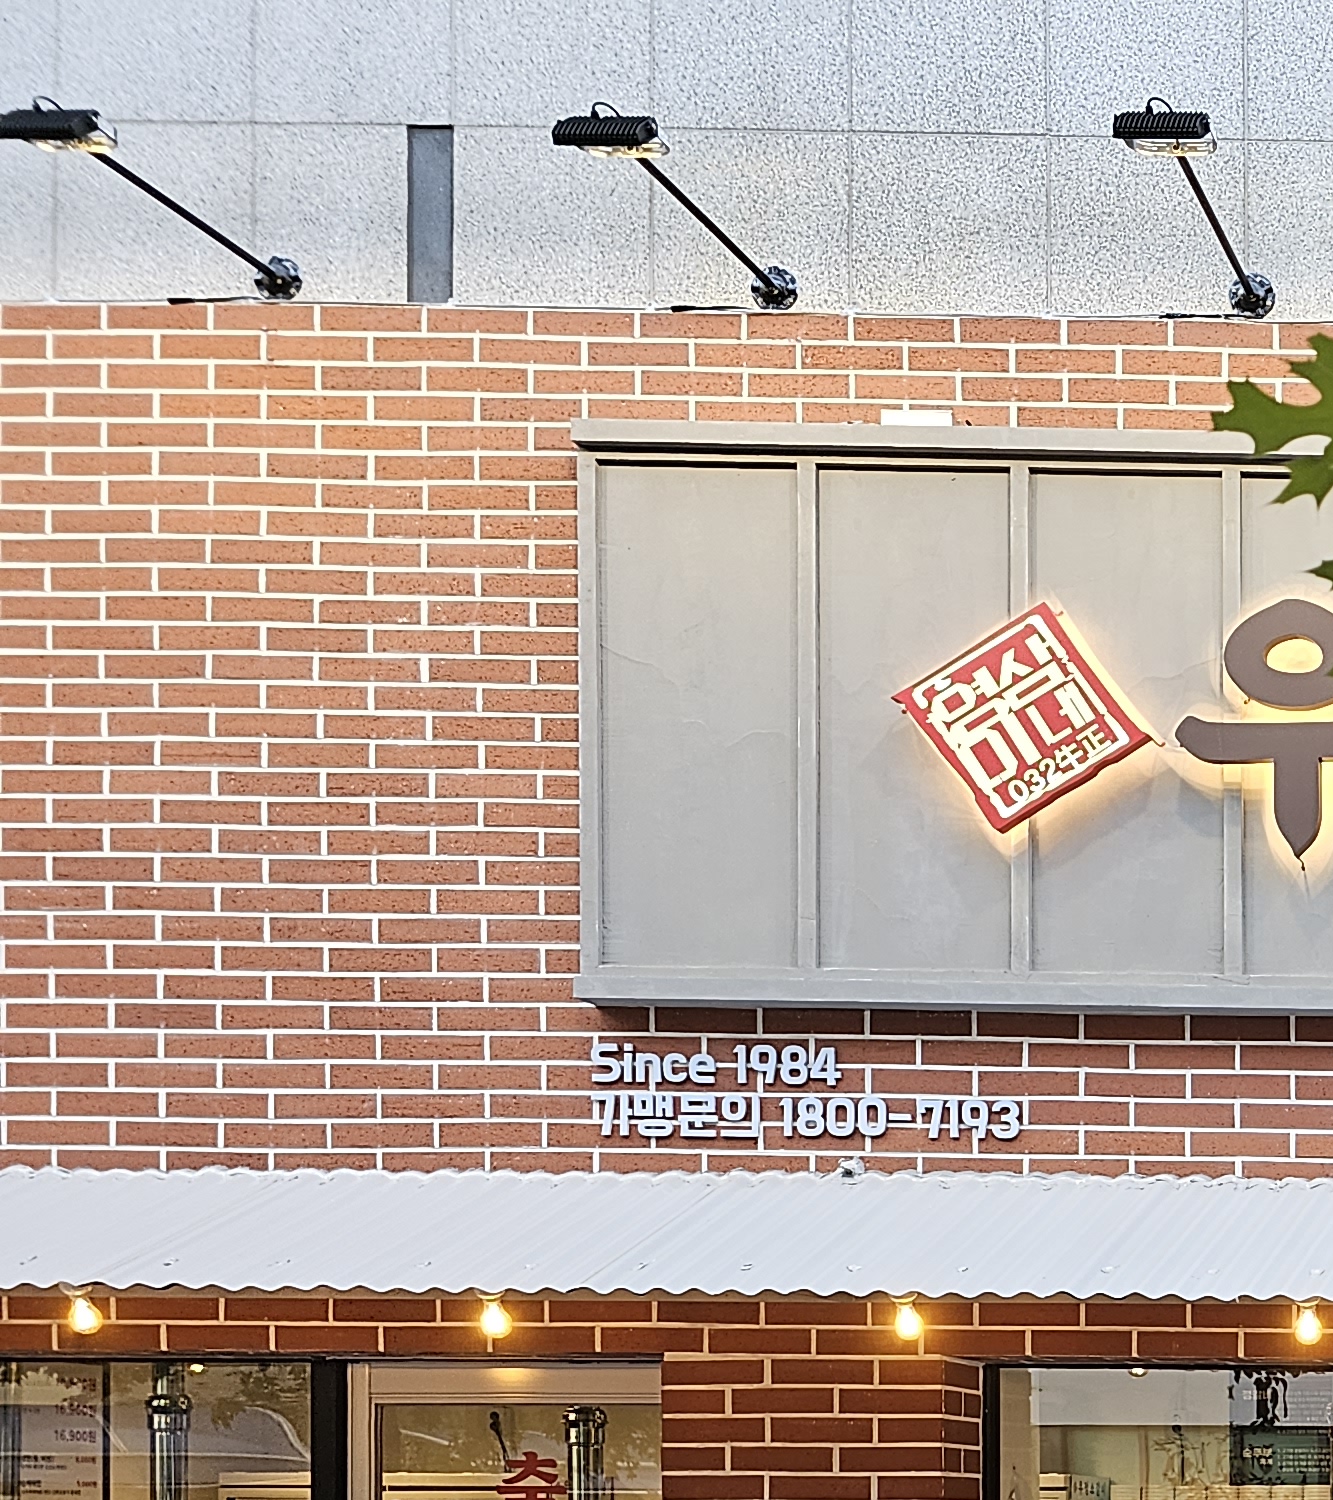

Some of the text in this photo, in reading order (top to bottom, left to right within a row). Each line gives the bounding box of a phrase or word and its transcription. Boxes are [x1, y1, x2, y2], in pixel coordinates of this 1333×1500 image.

[590, 1042, 842, 1087] Since 1984
[590, 1092, 1021, 1140] 가맹문의 1800-7193
